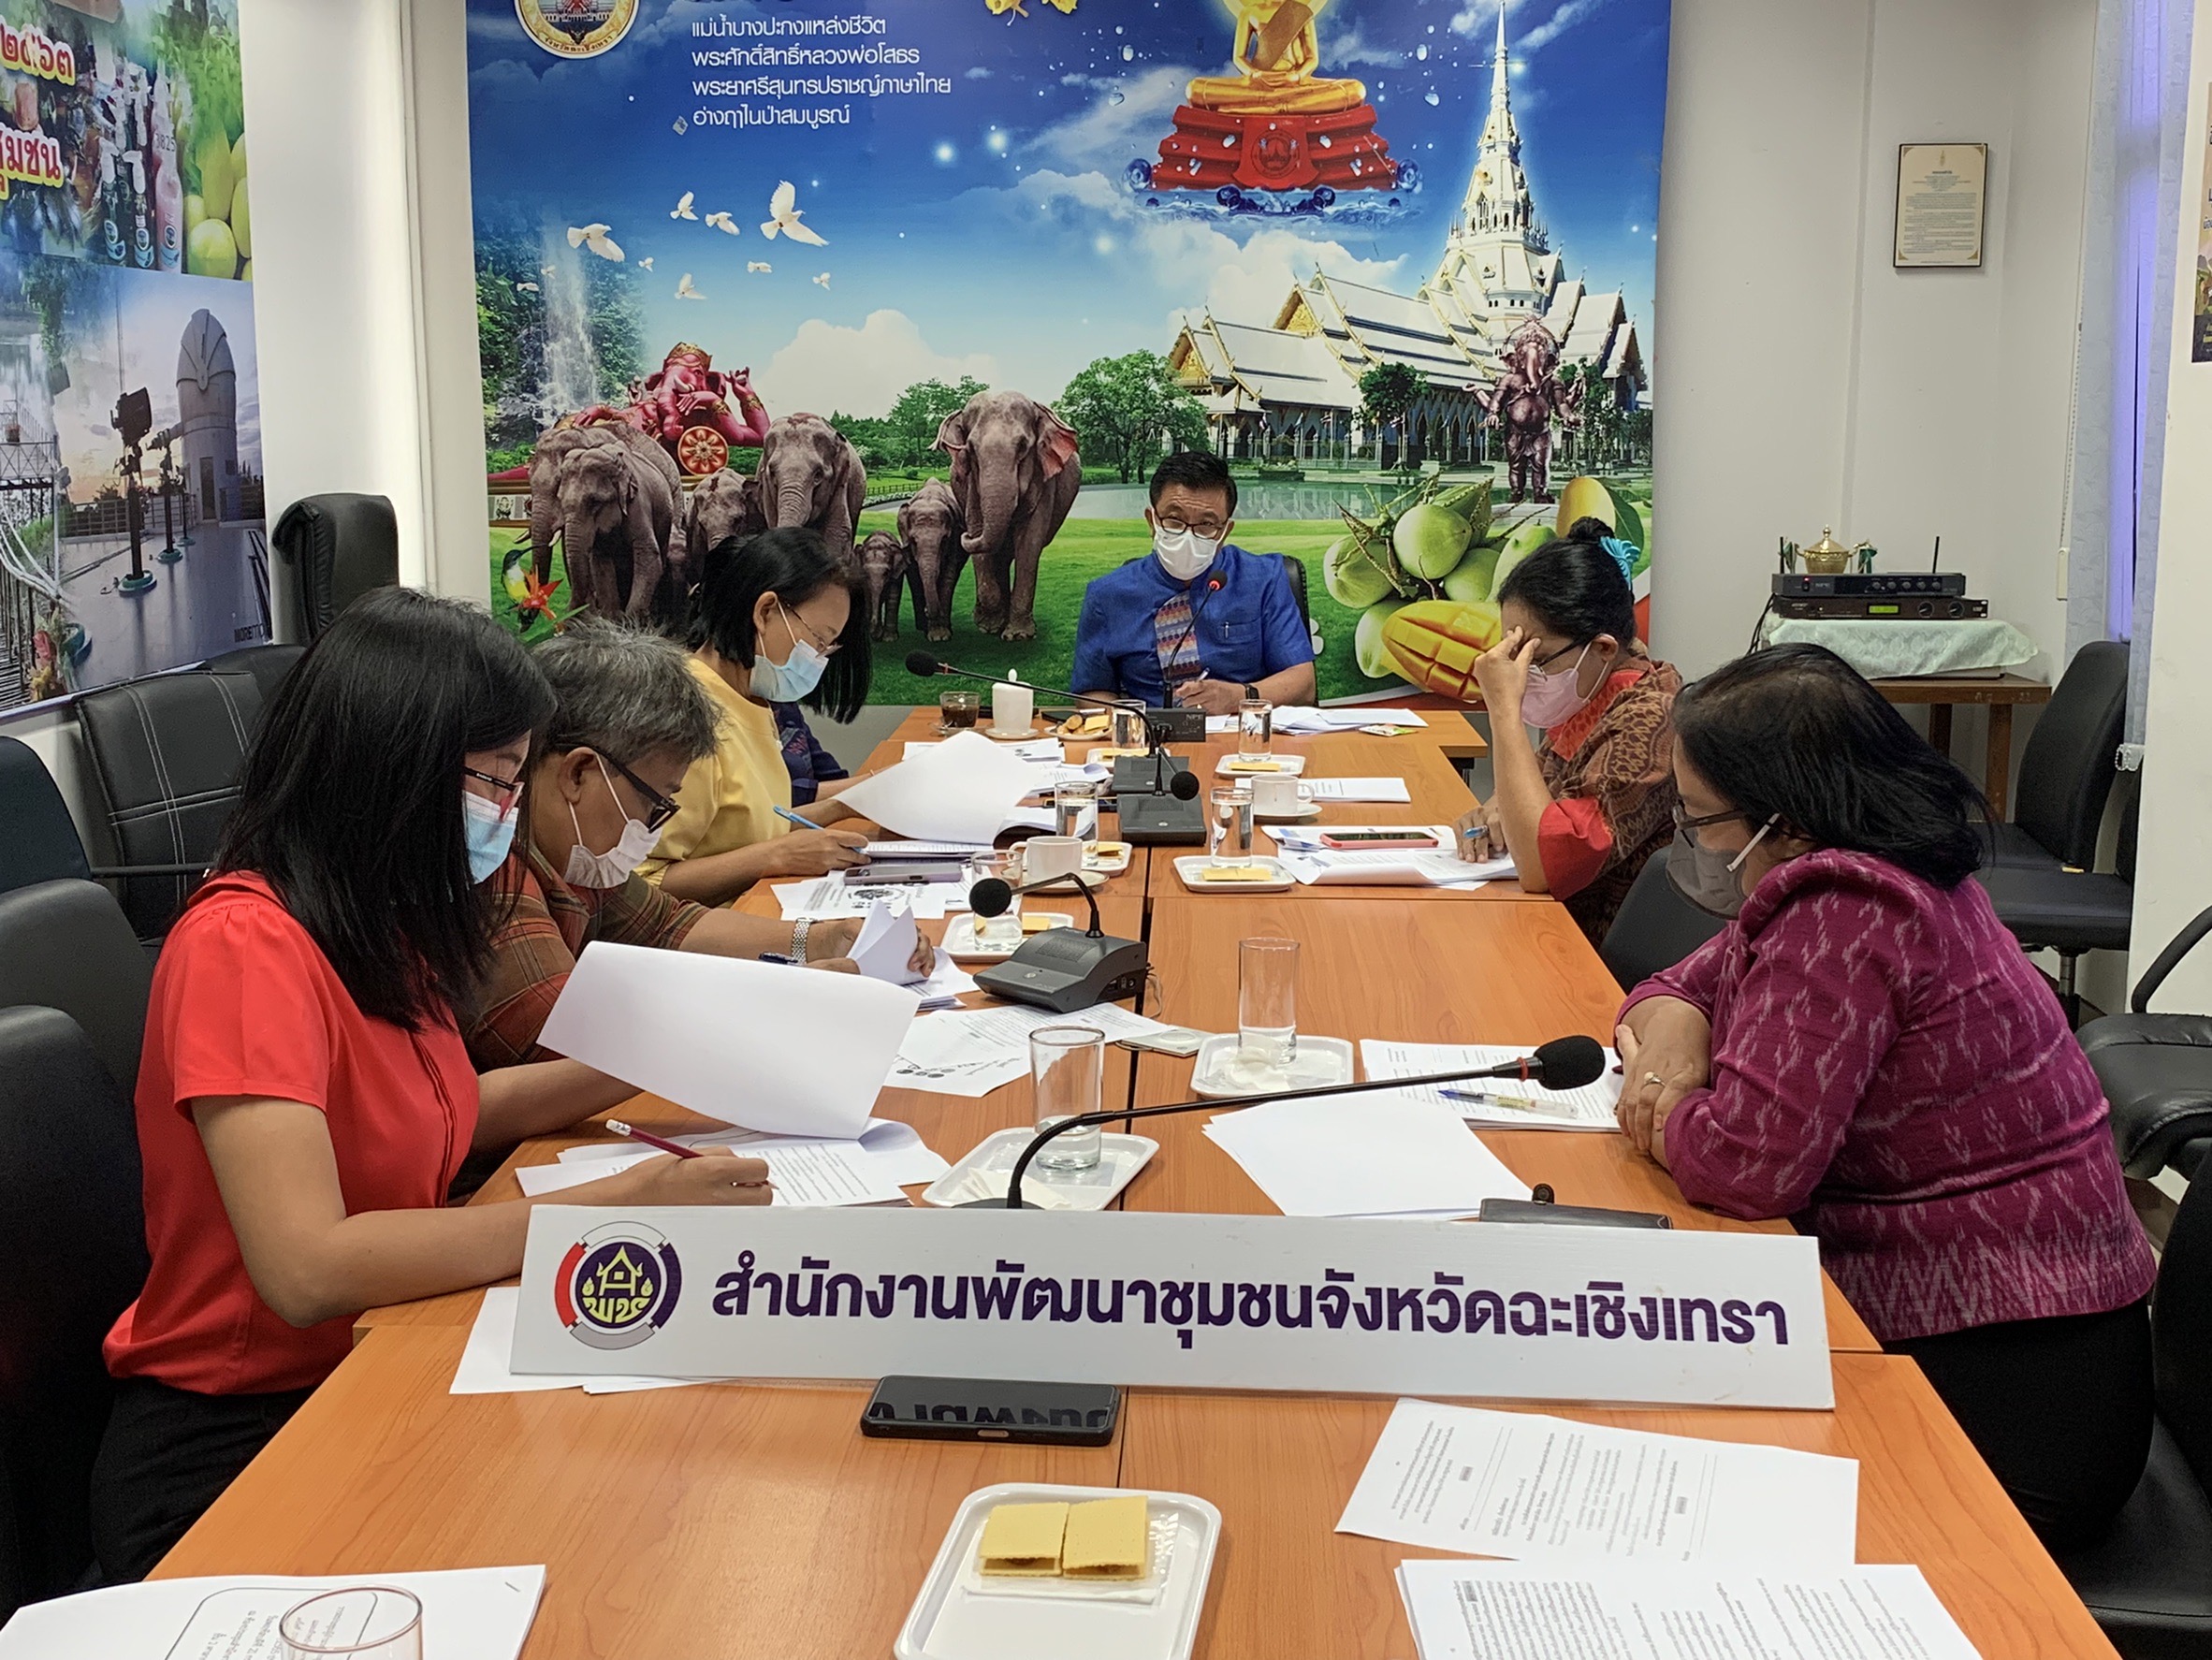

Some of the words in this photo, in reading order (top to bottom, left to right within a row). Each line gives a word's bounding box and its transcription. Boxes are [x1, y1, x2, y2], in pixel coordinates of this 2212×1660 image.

[691, 13, 886, 36] แม่น้ำบางปะกงแหล่งชีวิต
[691, 42, 920, 66] พระศักดิ์สิทธิ์หลวงพ่อโสธร
[691, 72, 952, 99] พระยาศรีสุนทรปราชญ์ภาษาไทย
[712, 1249, 1788, 1349] สำนักงานพัฒนาชุมชนจังหวัดฉะเชิงเทรา
